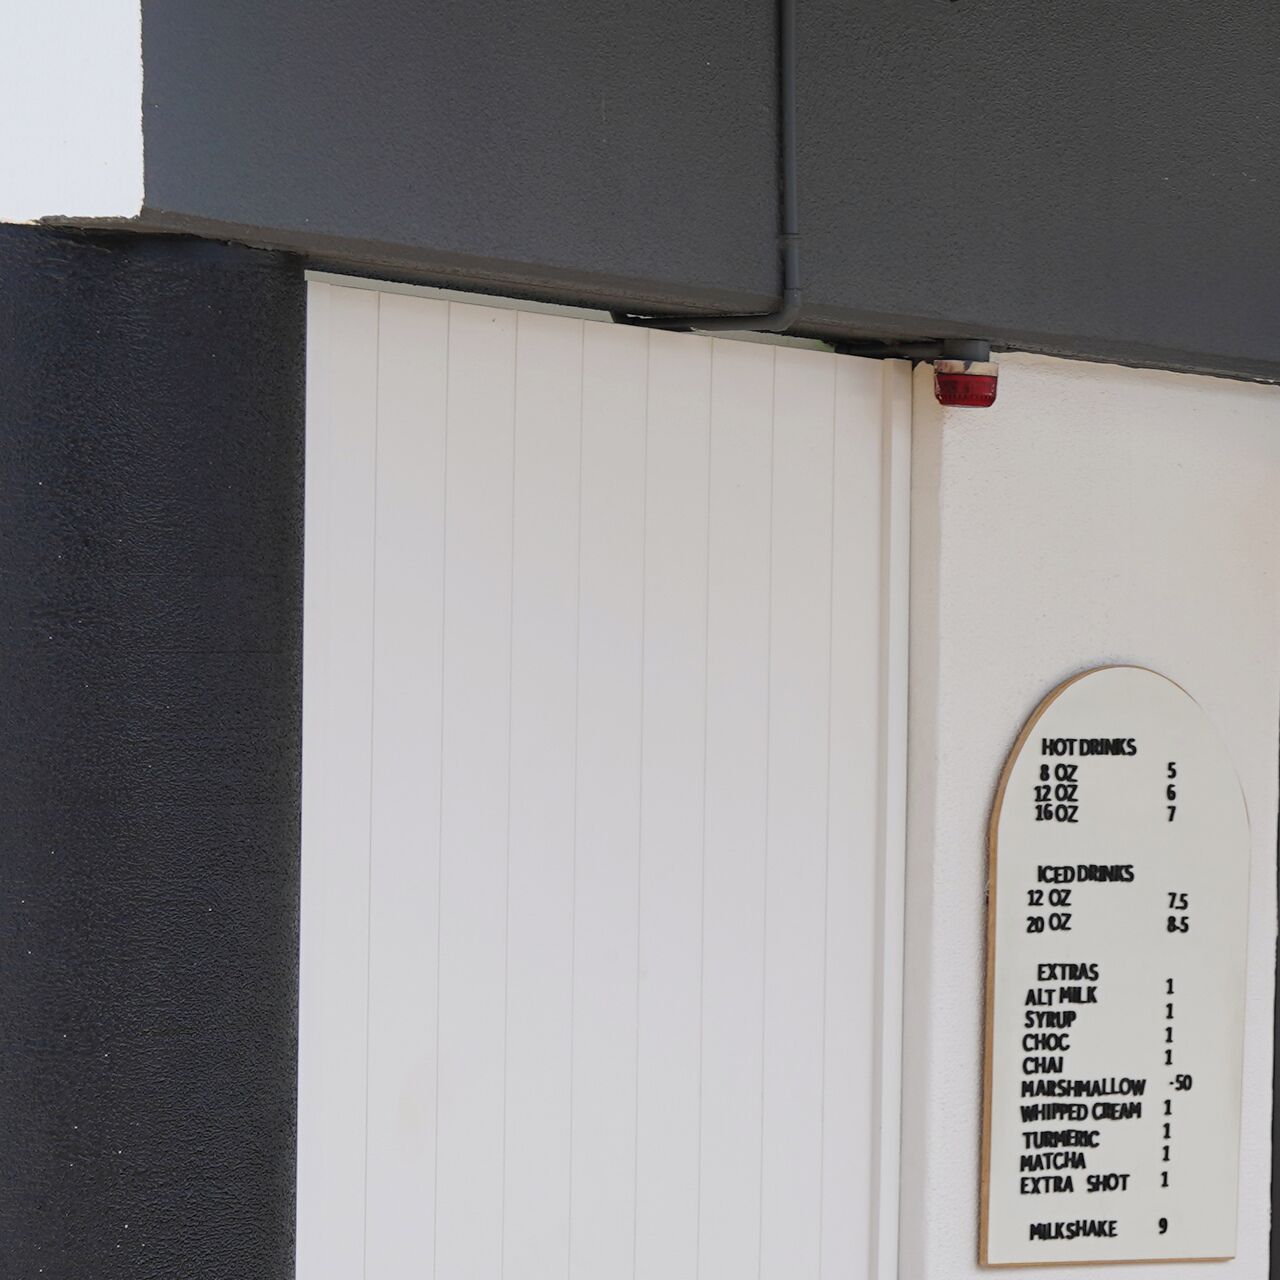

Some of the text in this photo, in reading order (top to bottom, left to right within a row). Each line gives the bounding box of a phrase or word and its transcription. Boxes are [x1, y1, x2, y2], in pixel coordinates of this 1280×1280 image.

[1042, 738, 1137, 756] HOT DRINKS
[1039, 761, 1177, 782] 8 OZ 5
[1034, 783, 1177, 802] 12 OZ 6
[1035, 804, 1177, 823] 16 OZ 7
[1038, 864, 1134, 884] ICED DRINKS
[1028, 890, 1043, 906] 12
[1049, 889, 1071, 906] OZ
[1027, 916, 1044, 933] 20
[1049, 913, 1071, 931] OZ
[1038, 963, 1099, 981] EXTRAS
[1025, 977, 1175, 1006] ALT MILK 1
[1024, 1002, 1174, 1029] SYRUP 1
[1022, 1026, 1174, 1052] CHOC 1
[1023, 1048, 1173, 1075] CHAI 1
[1021, 1078, 1146, 1097] MARSHMALLOW
[1020, 1099, 1173, 1123] WHIPPED CREAM 1
[1022, 1122, 1171, 1149] TURMERIC 1
[1020, 1144, 1170, 1172] MATCHA 1
[1020, 1170, 1169, 1194] EXTRA SHOT 1
[1030, 1217, 1169, 1240] MILKSHAKE 9
